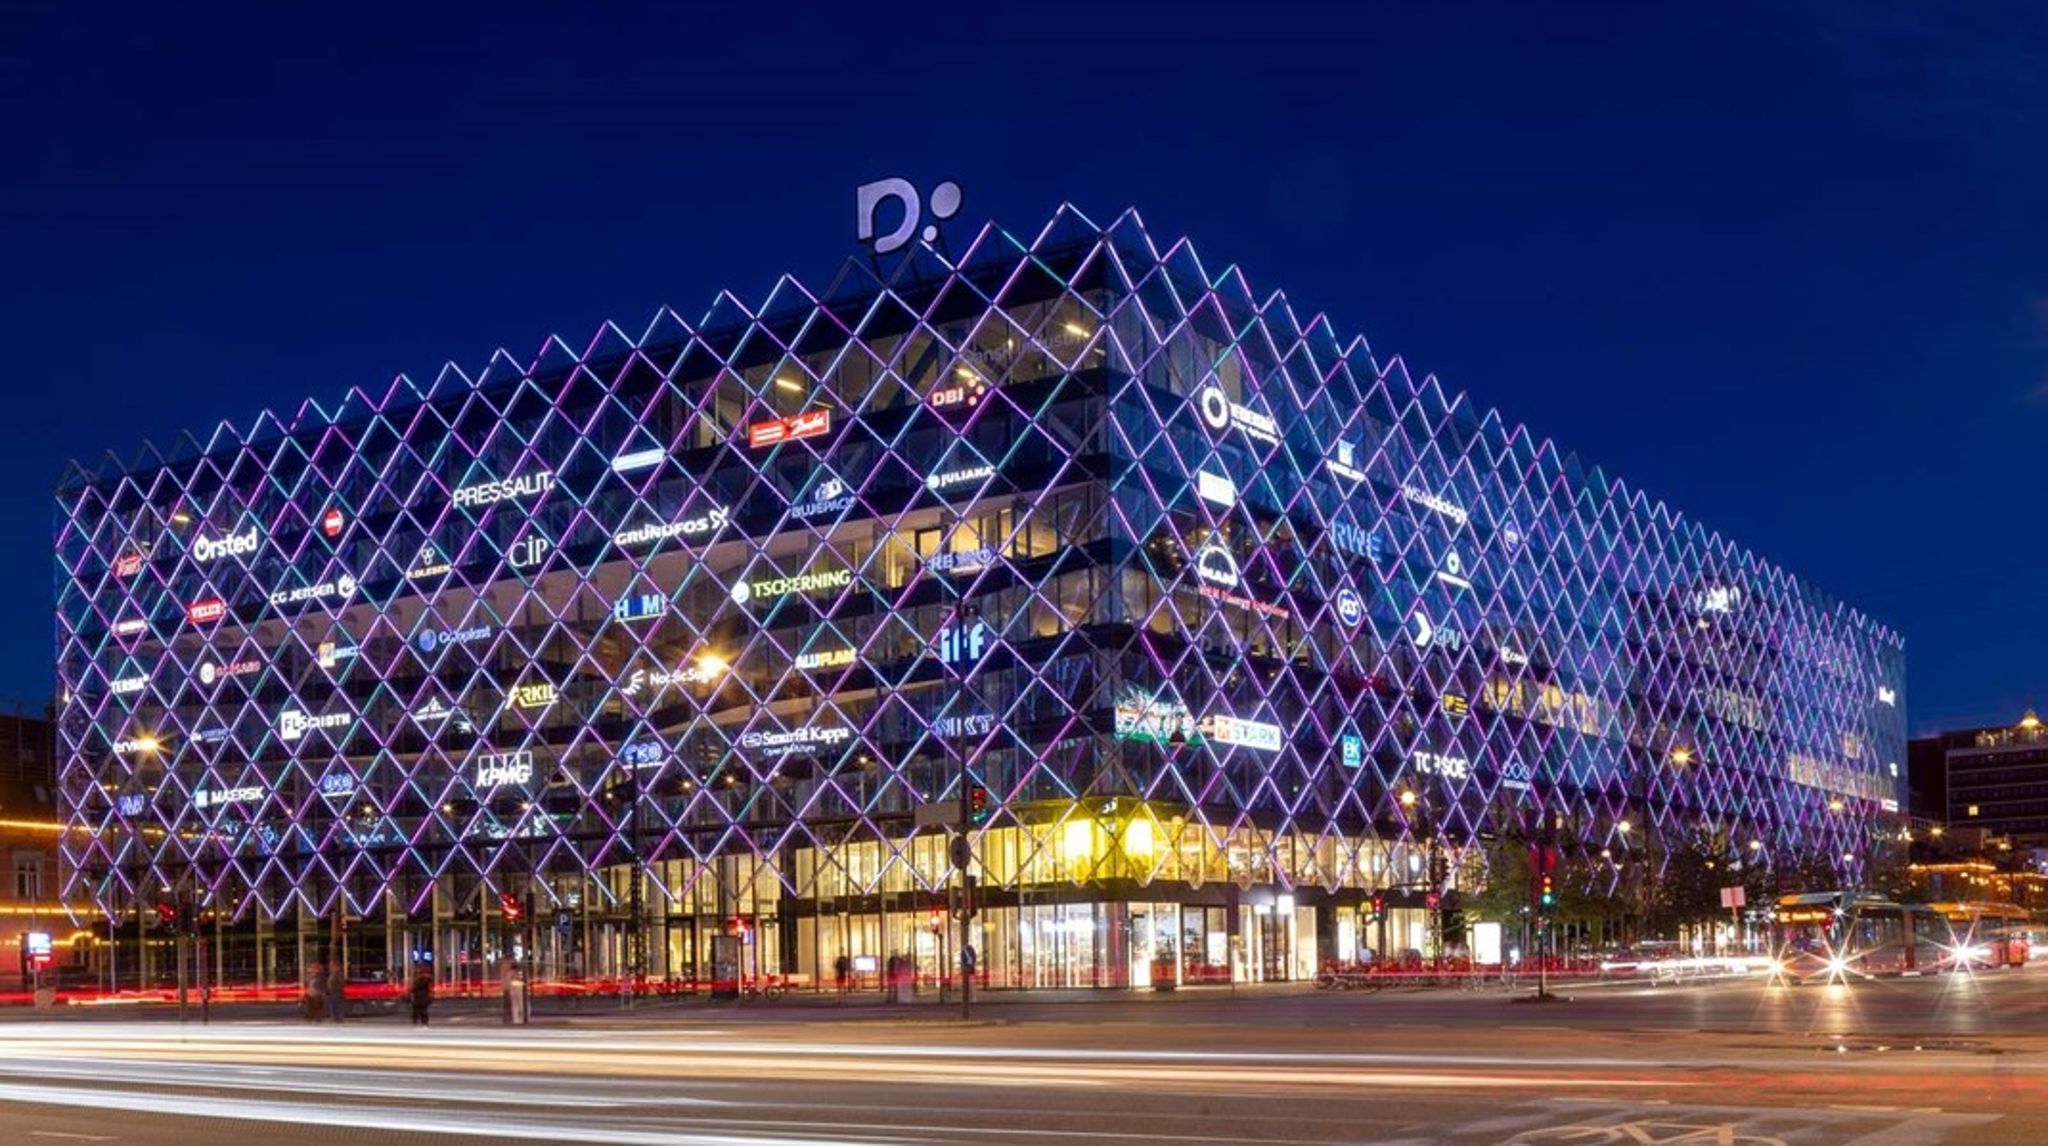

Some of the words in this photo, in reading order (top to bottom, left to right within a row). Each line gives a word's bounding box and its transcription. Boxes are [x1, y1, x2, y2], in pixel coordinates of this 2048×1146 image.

[932, 386, 964, 407] DBI
[614, 517, 708, 545] GRUNDFOS
[753, 570, 852, 597] TSCHERNING
[810, 726, 849, 745] Kappa
[475, 764, 531, 788] KPMG
